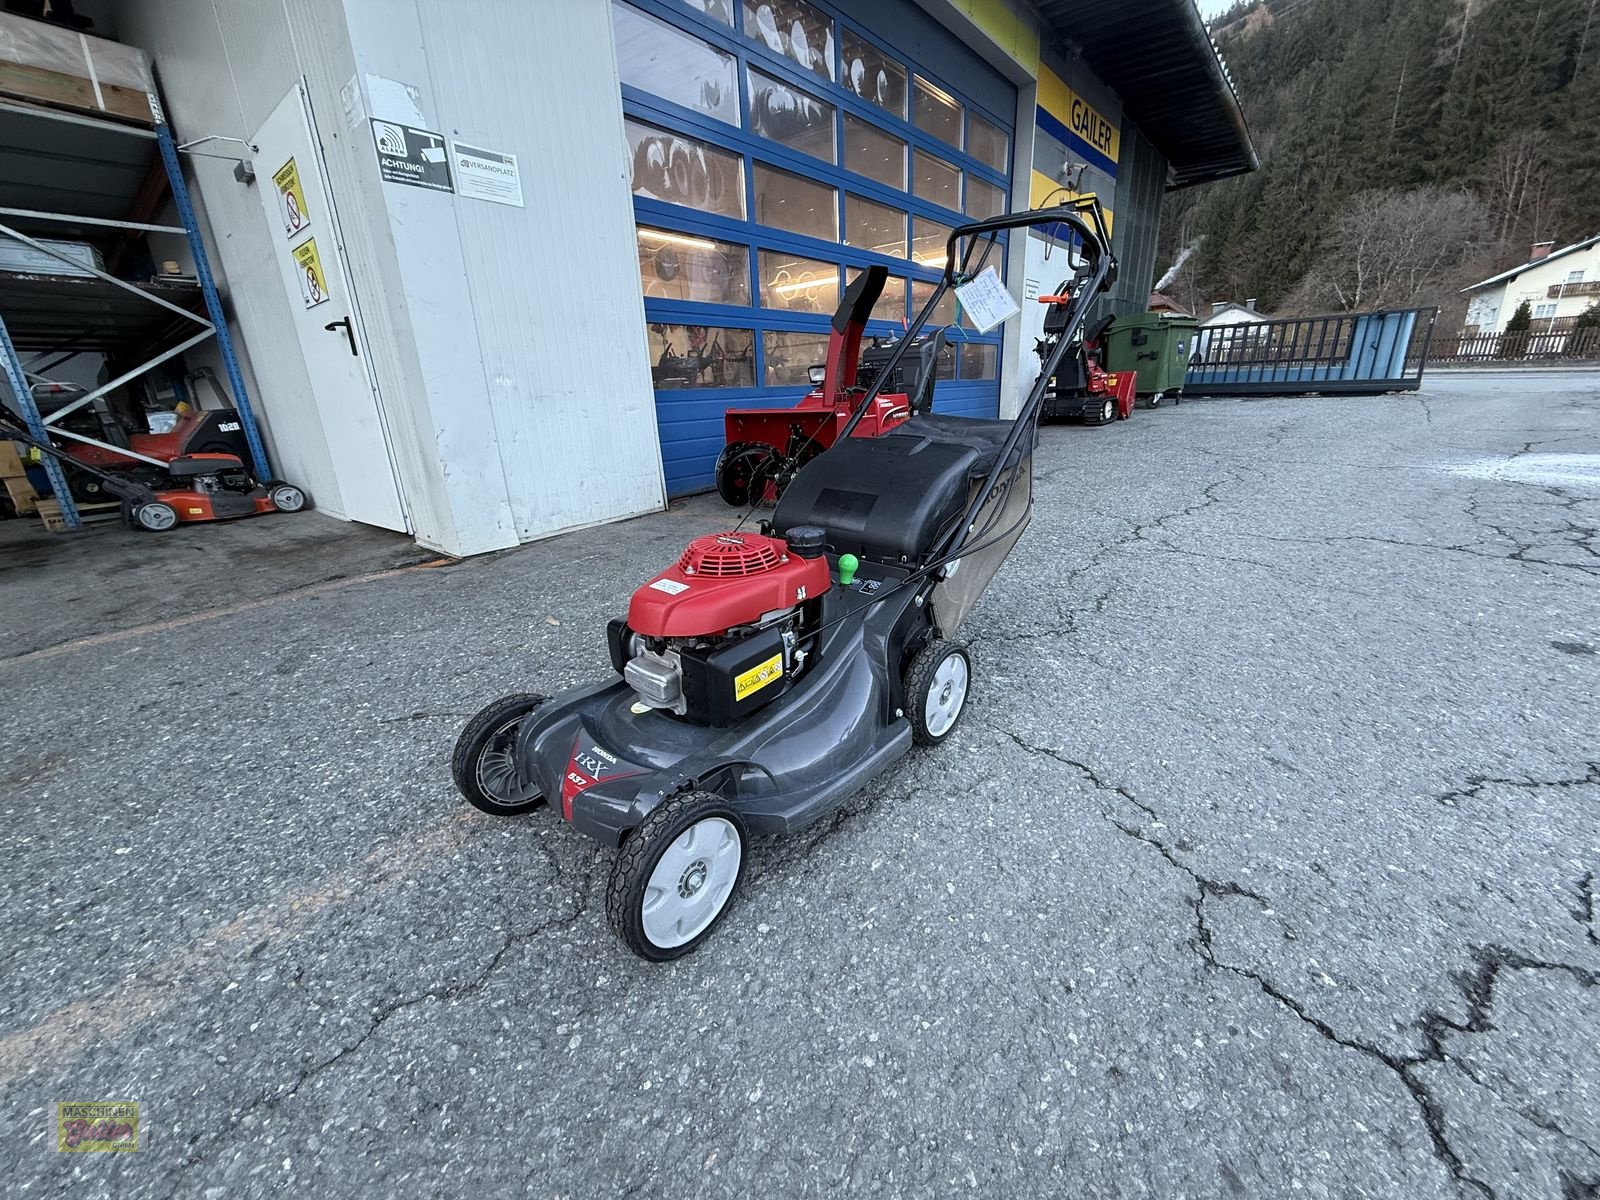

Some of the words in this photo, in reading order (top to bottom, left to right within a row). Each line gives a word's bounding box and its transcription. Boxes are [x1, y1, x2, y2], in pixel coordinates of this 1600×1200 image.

[1071, 98, 1112, 155] GAILER
[381, 145, 405, 155] ALARM
[381, 157, 425, 173] ACHTUNG!
[469, 161, 514, 177] VERSANDPLATZ
[217, 421, 240, 432] 1028
[591, 745, 618, 765] HONDA
[573, 751, 610, 782] HRX
